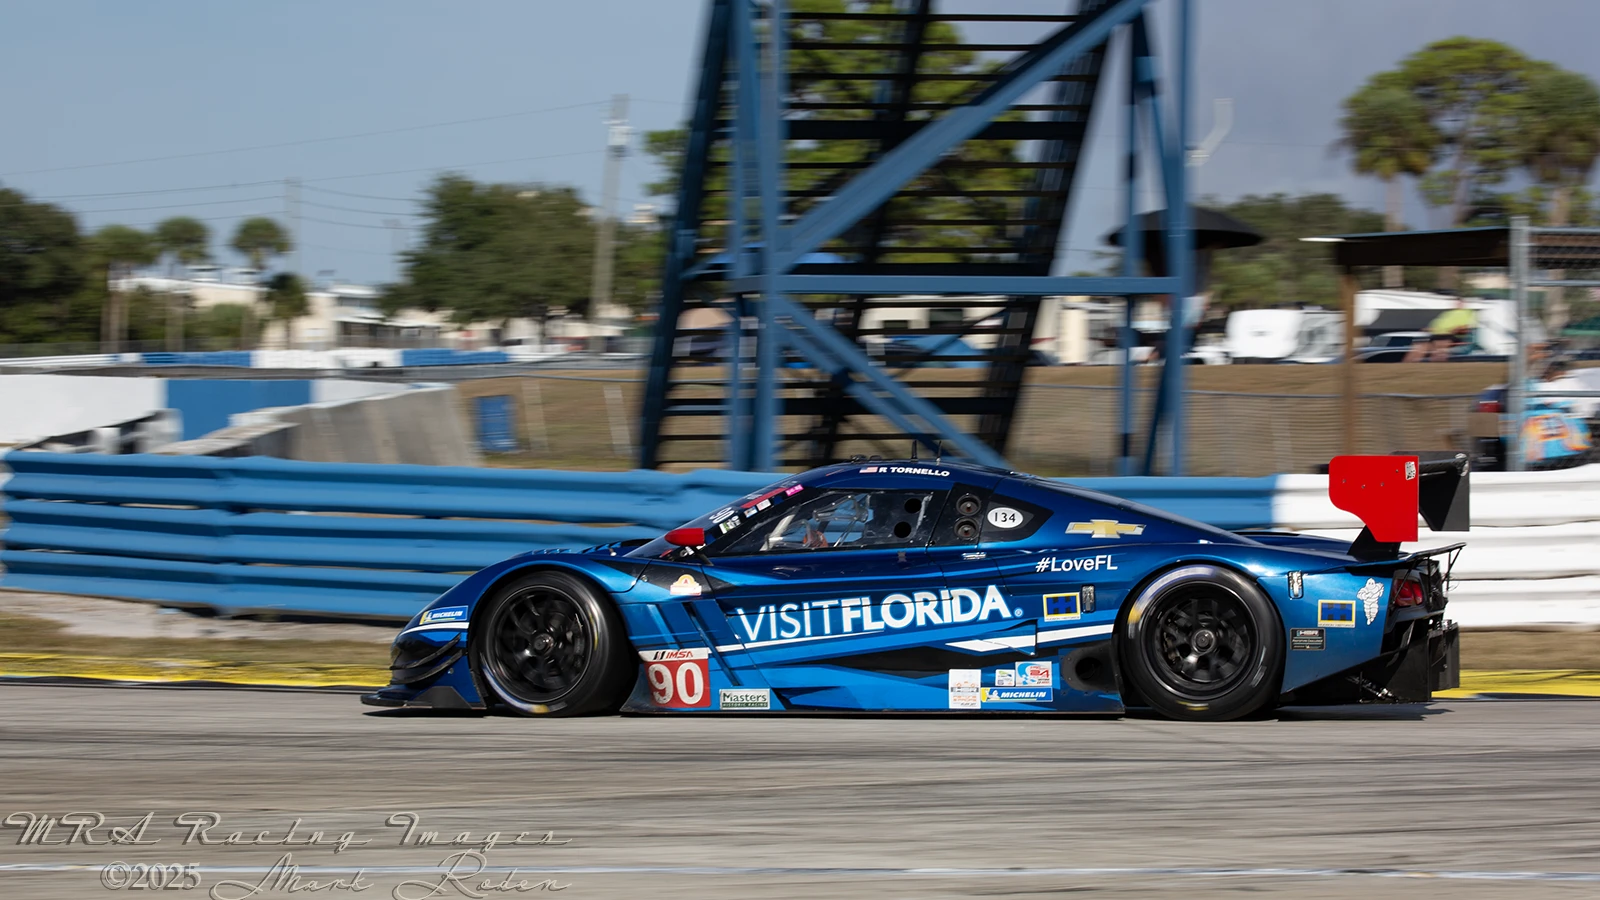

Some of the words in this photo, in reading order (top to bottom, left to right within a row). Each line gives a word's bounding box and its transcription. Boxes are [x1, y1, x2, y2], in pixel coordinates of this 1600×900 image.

[890, 466, 950, 477] TORNELLO
[993, 512, 1016, 523] 134
[1035, 554, 1119, 573] #LoveFL
[665, 650, 694, 660] IMSA
[648, 661, 704, 705] 90
[722, 692, 767, 702] Masters
[1000, 691, 1047, 699] MICHELIN
